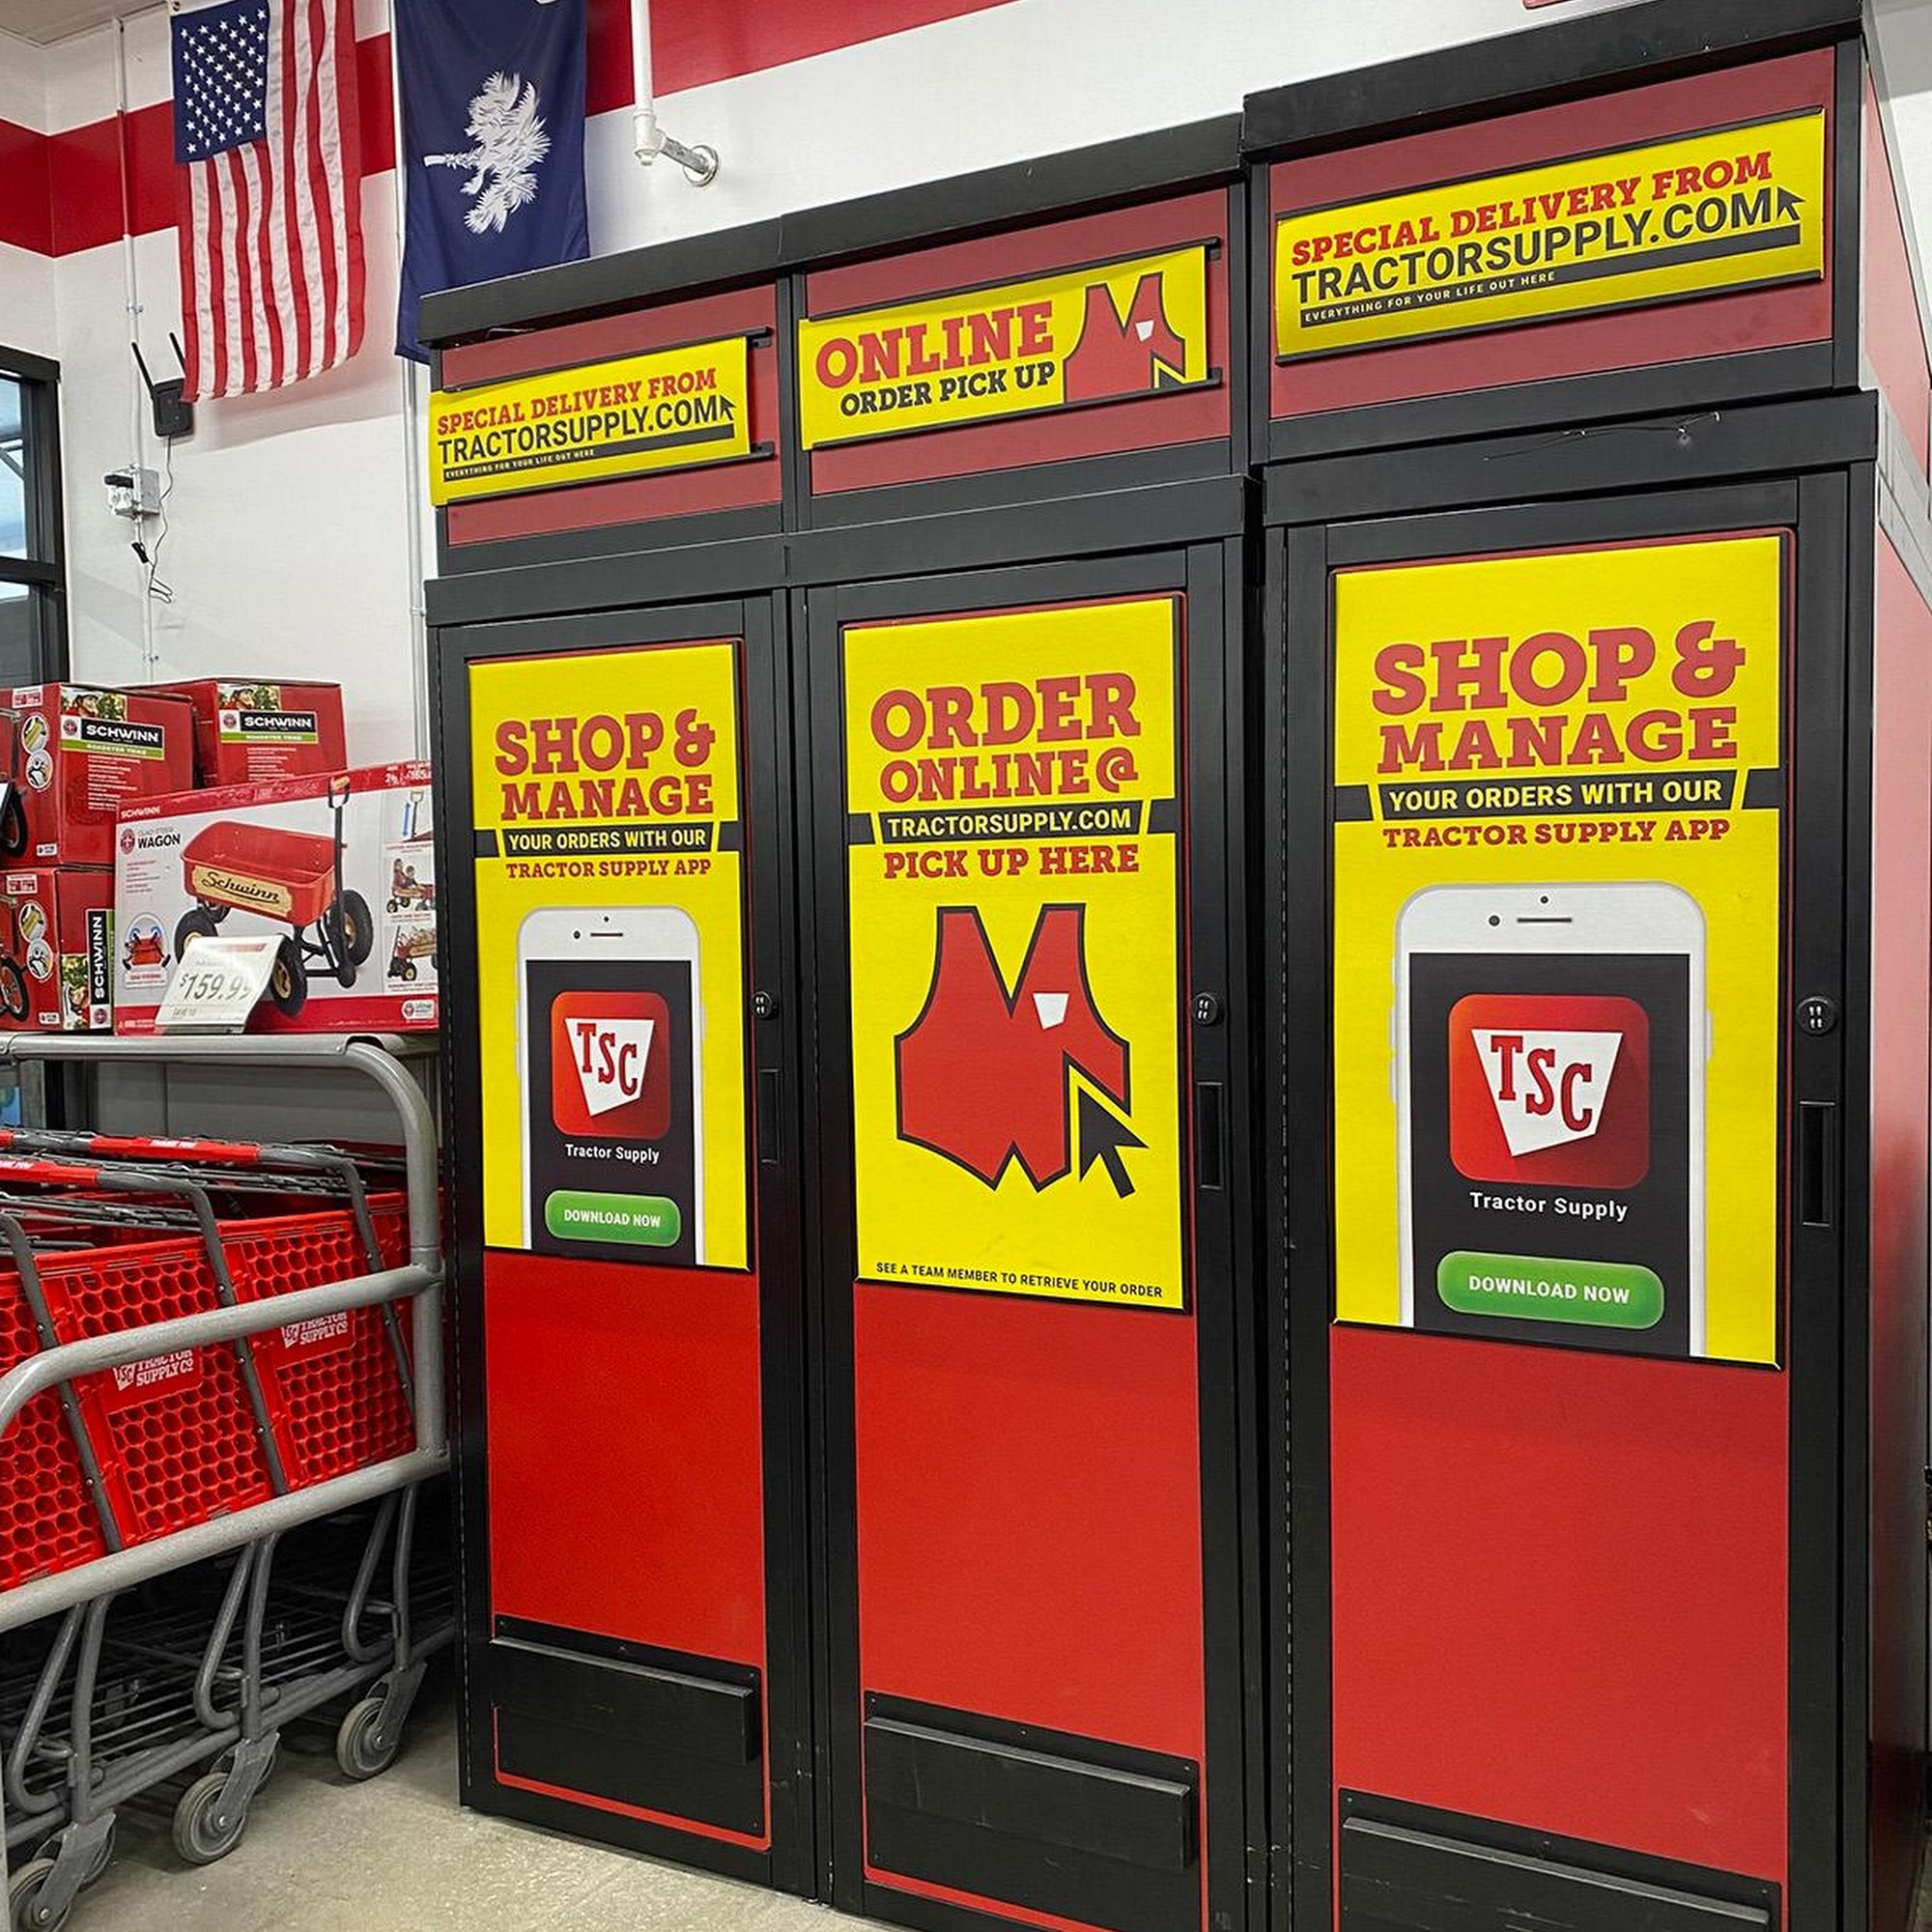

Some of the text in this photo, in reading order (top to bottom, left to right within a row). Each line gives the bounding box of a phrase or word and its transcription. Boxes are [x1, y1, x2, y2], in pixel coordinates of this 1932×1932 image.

[1292, 151, 1772, 267] SPECIAL DELIVERY FROM
[1292, 187, 1772, 304] TRACTORSUPPLY.COM
[1305, 270, 1556, 324] EVERYTHING FOR YOUR LIFE OUT HERE
[815, 300, 1054, 388] ONLINE
[438, 368, 717, 436] SPECIAL DELIVERY FROM
[840, 361, 1056, 417] ORDER PICK UP
[439, 394, 717, 464] TRACTORSUPPLY.COM
[445, 448, 594, 480] EVERYTHING FOR YOUR LIFE OUT HERE
[1372, 620, 1746, 716] SHOP &
[244, 716, 312, 727] SCHWINN
[870, 671, 1141, 753] ORDER
[86, 724, 158, 742] SCHWINN
[495, 708, 716, 777] SHOP &
[1377, 705, 1738, 774] MANAGE
[880, 747, 1139, 804] ONLINE @
[501, 774, 714, 821] MANAGE
[1388, 779, 1722, 812] YOUR ORDERS WITH OUR
[137, 834, 181, 848] WAGON
[509, 828, 706, 851] YOUR ORDERS WITH OUR
[888, 809, 1131, 838] TRACTORSUPPLY.COM
[1383, 819, 1730, 848] TRACTOR SUPPLY APP
[505, 858, 712, 879] TRACTOR SUPPLY APP
[884, 843, 1140, 879] PICK UP HERE
[202, 870, 280, 904] Schwinn
[93, 917, 105, 999] SCHWINN
[577, 1023, 638, 1096] TSC
[1491, 1035, 1593, 1132] TSC
[565, 1144, 660, 1164] Tractor Supply
[564, 1209, 661, 1228] DOWNLOAD NOW
[1470, 1192, 1628, 1223] Tractor Supply
[876, 1262, 1163, 1298] SEE A TEAM MEMBER TO RETRIEVE YOUR ORDER
[1468, 1276, 1630, 1304] DOWNLOAD NOW
[136, 1361, 180, 1387] SUPPLY
